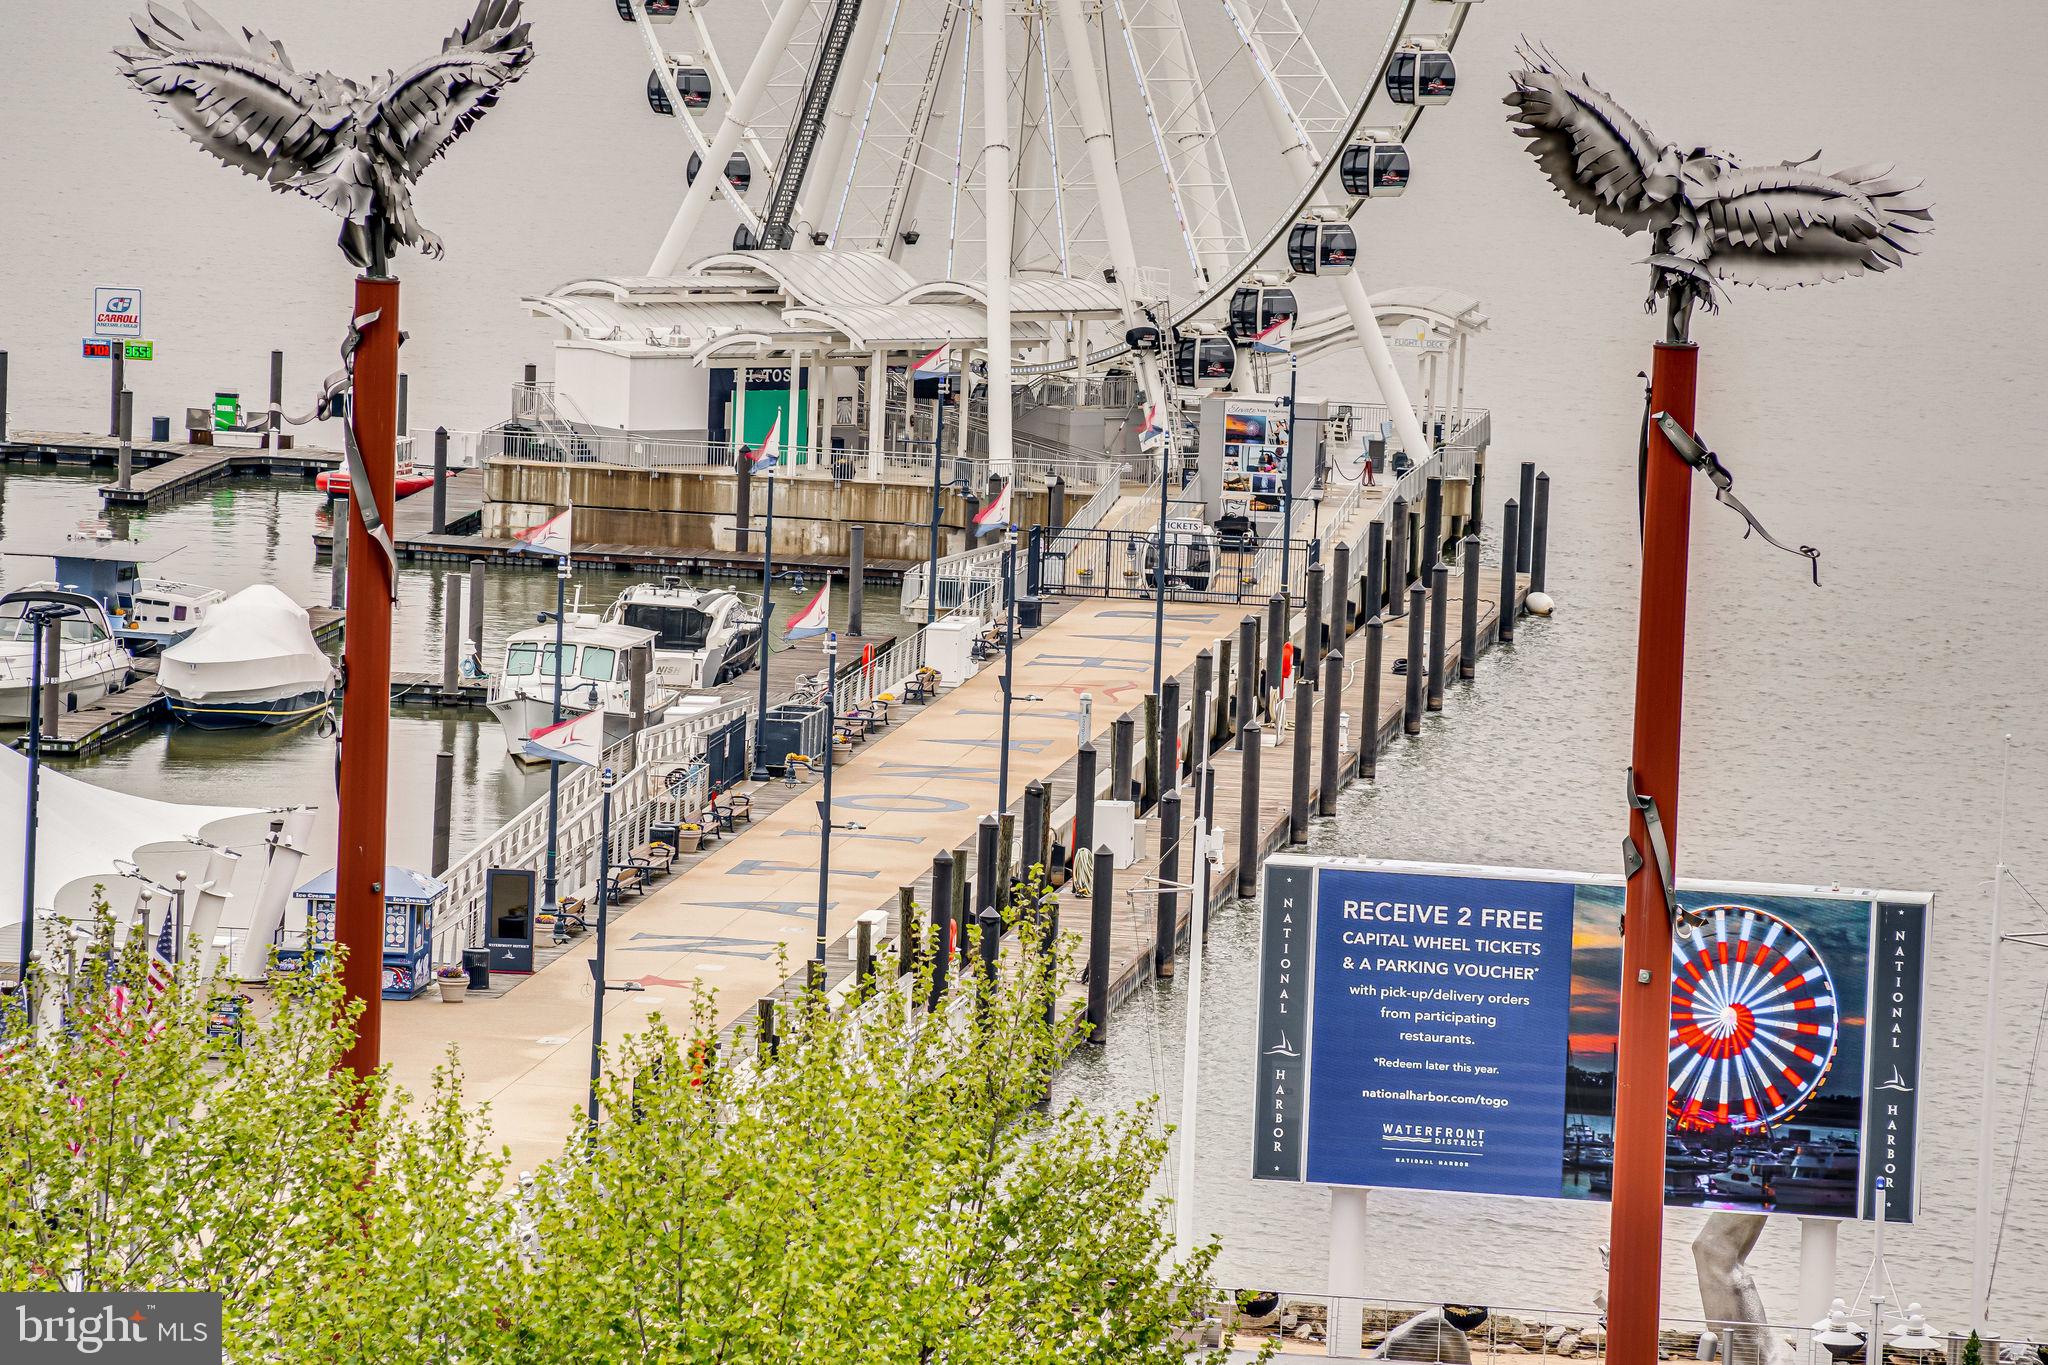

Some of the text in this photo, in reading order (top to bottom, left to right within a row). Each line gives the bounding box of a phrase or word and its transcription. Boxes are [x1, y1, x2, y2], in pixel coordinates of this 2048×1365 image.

[97, 313, 139, 324] CARROLL
[1394, 339, 1444, 348] FLIGHT DECK
[1165, 521, 1199, 531] ICKETS
[1343, 899, 1544, 931] RECEIVE 2 FREE
[1342, 931, 1541, 956] CAPITAL WHEEL TICKETS
[1279, 897, 1294, 1014] NATIONAL
[1342, 956, 1355, 970] &
[1359, 957, 1372, 971] A
[1376, 958, 1449, 975] PARKING
[1349, 985, 1530, 1006] with pick-up/delivery orders
[1892, 930, 1906, 1048] NATIONAL
[1380, 1007, 1497, 1028] from participating
[1399, 1031, 1476, 1045] restaurants.
[1425, 1060, 1449, 1071] later
[1452, 1062, 1472, 1073] this
[1474, 1066, 1500, 1076] year.
[1362, 1088, 1509, 1109] nationalharbor.com/togo
[1273, 1069, 1286, 1153] HARBOR
[1382, 1123, 1485, 1140] WATERFRONT
[1434, 1137, 1485, 1147] DISTRICT
[1885, 1104, 1898, 1189] HARBOR
[1395, 1157, 1434, 1165] NATIONAL
